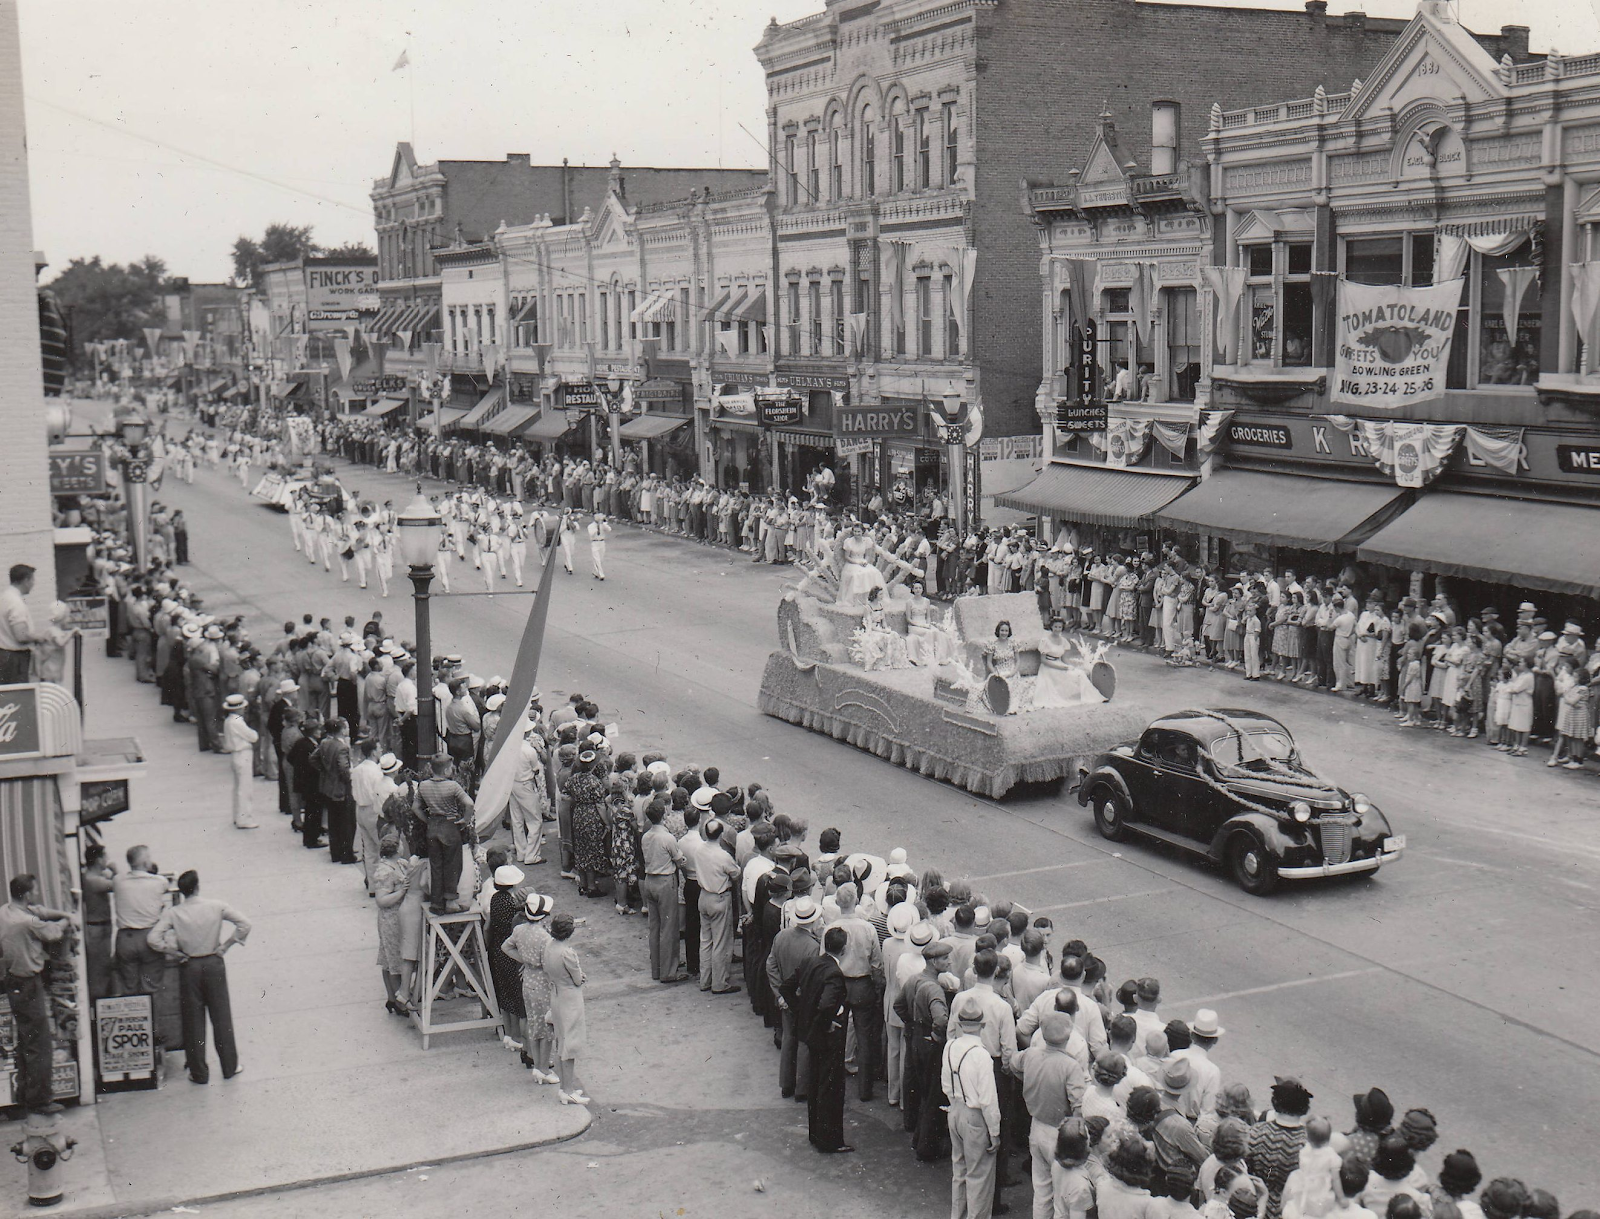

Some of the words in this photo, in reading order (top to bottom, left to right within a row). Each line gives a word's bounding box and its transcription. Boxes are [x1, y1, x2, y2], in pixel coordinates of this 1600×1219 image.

[1407, 157, 1425, 166] EAGL
[1439, 152, 1461, 163] BLOCK
[310, 271, 364, 289] FINCK'S
[1342, 303, 1453, 333] TOMATOLAND
[1340, 344, 1376, 363] GREETS
[1412, 337, 1451, 362] YOU!
[724, 373, 753, 383] UHLMAN'S
[1352, 365, 1397, 377] BOWLING
[1399, 364, 1431, 376] GREEN
[376, 379, 404, 388] ELKS
[789, 376, 832, 388] UHLMAN'S
[1339, 379, 1362, 396] AUG.
[765, 408, 797, 416] FLORSHEIM
[842, 407, 914, 432] HARRY'S
[1068, 408, 1106, 417] LUNCHES
[1067, 420, 1106, 429] SWEETS
[1231, 427, 1287, 444] GROCERIES
[999, 438, 1014, 460] 12
[967, 455, 975, 524] HARRY
[118, 1024, 146, 1032] PAUL
[112, 1033, 149, 1049] SPOR
